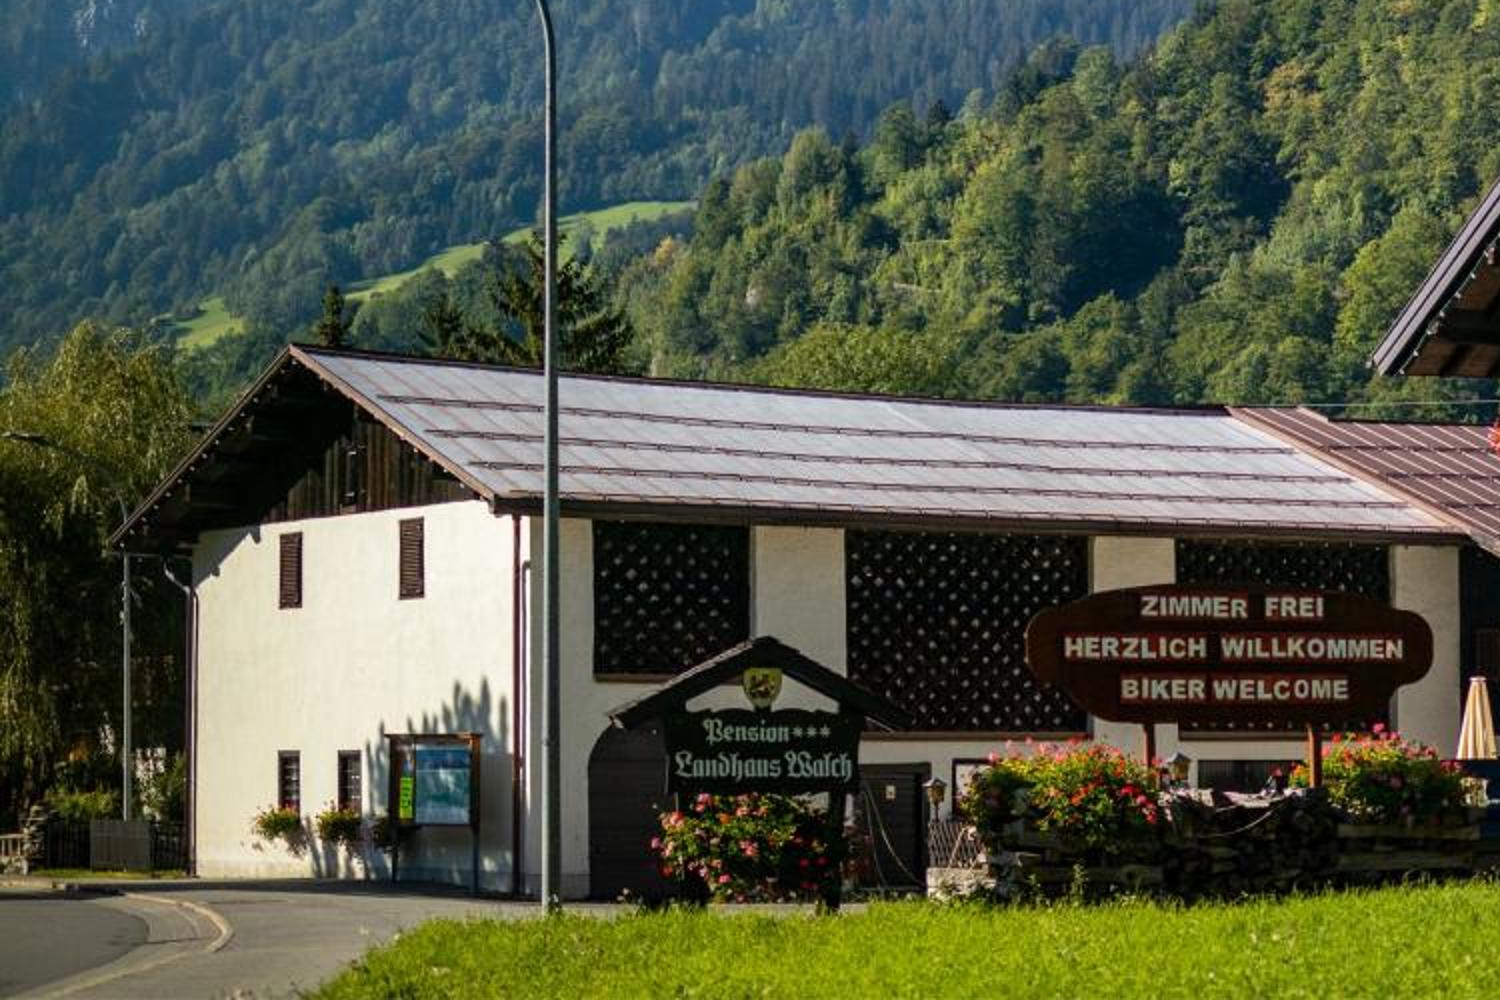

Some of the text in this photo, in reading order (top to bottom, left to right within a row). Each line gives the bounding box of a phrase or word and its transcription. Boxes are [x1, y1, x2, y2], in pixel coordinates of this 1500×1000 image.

[1141, 596, 1324, 618] ZIMMER FREI
[1063, 636, 1404, 659] HERZLICH WILLKOMMEN
[1121, 678, 1348, 699] BIKER WELCOME
[703, 718, 789, 745] Pension
[674, 751, 852, 782] Landhaus Walch
